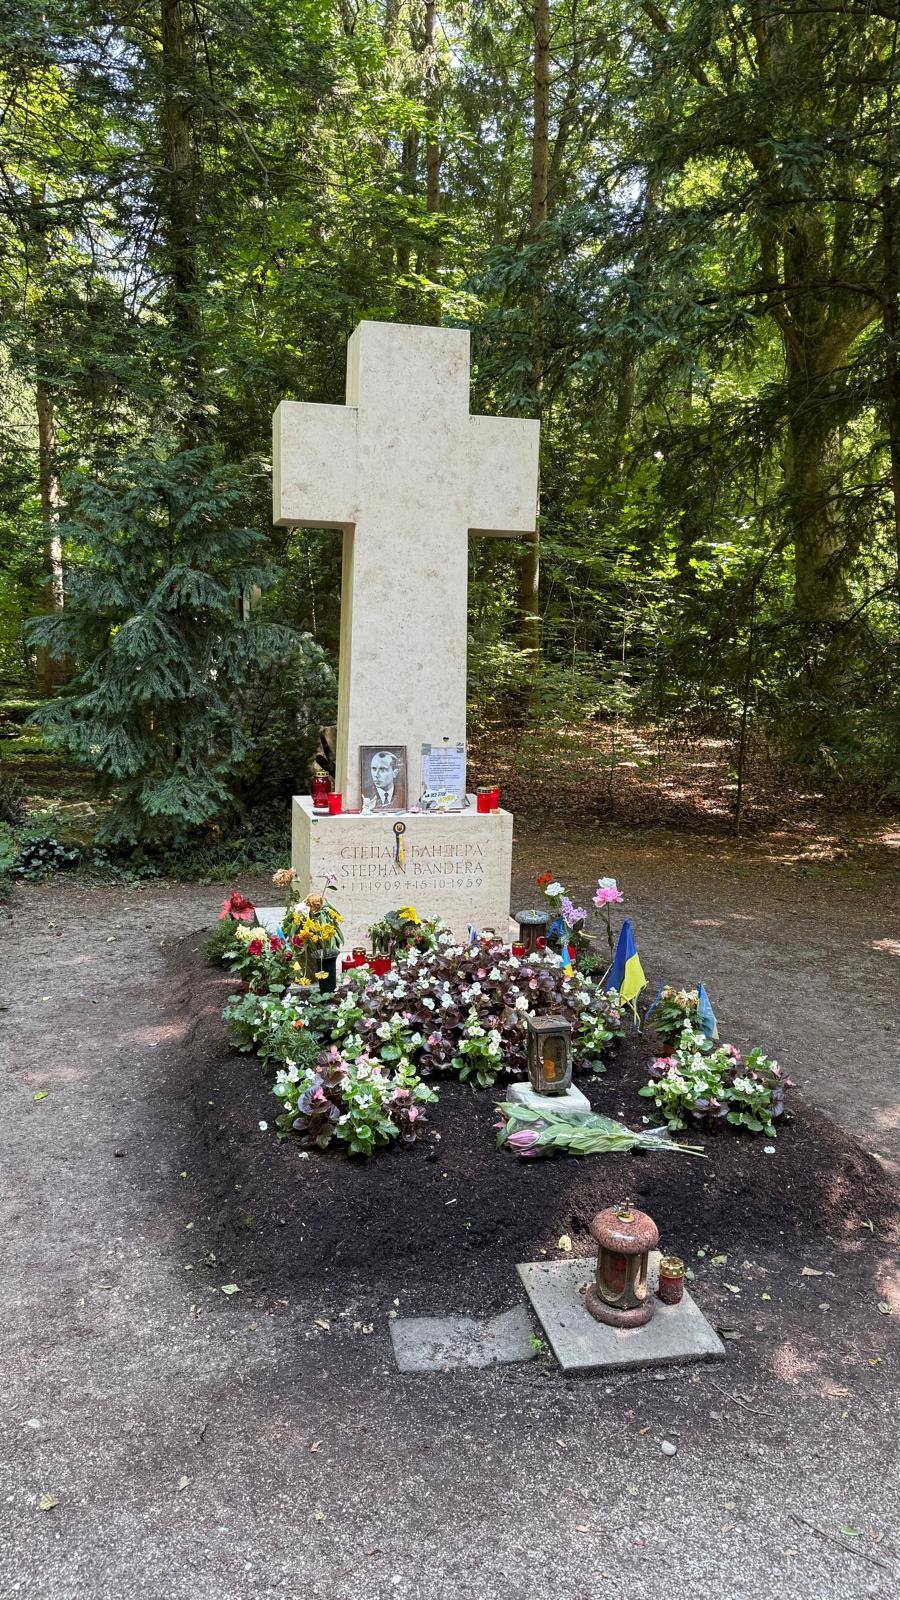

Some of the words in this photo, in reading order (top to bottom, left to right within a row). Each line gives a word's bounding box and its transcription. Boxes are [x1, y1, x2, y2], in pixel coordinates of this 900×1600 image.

[411, 844, 483, 857] БАНДЕРА
[341, 863, 407, 877] STEPHAN
[413, 862, 484, 875] BANDERA
